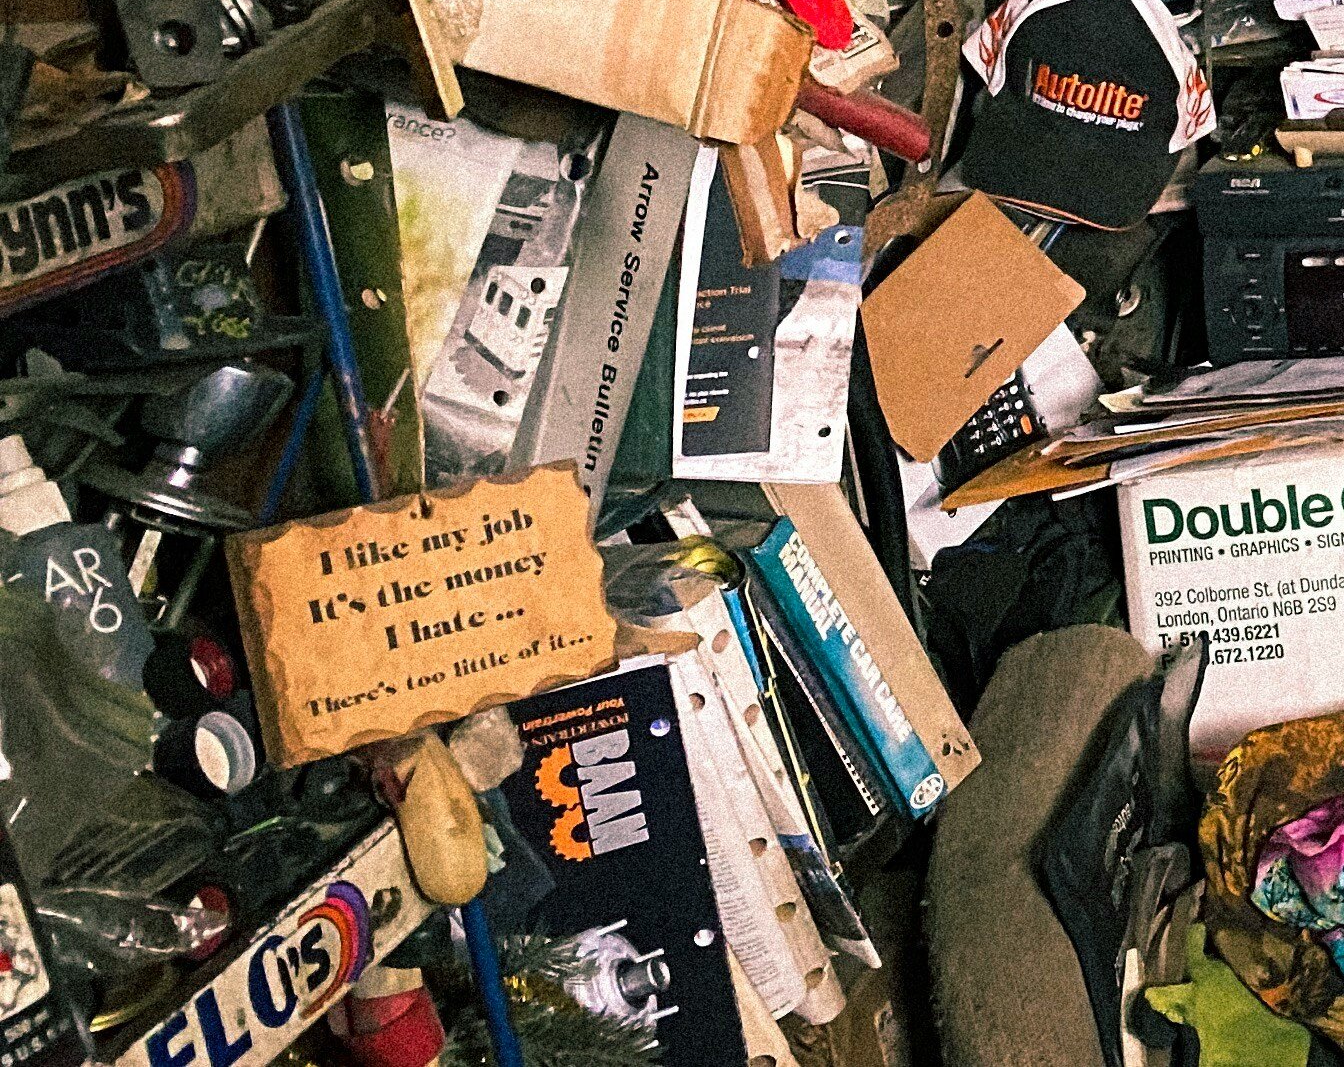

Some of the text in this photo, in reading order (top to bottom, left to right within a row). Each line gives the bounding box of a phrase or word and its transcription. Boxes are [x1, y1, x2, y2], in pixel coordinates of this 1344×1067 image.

[1035, 64, 1144, 120] Autolite
[1066, 107, 1096, 123] change
[631, 162, 660, 244] Arrow
[603, 251, 643, 355] Service
[584, 364, 620, 473] Bulletin
[319, 508, 535, 576] I like my job
[1142, 483, 1335, 545] Double
[1148, 543, 1214, 566] PRINTING
[1229, 536, 1300, 559] GRAPHICS
[88, 586, 123, 634] 6
[307, 551, 549, 626] It's the money
[779, 545, 837, 642] MANUAL
[1154, 590, 1183, 608] 392
[1186, 582, 1251, 606] Colborne
[1253, 581, 1274, 598] St.
[1276, 578, 1297, 599] (at
[1156, 596, 1337, 630] London, Ontario N6B 2S9
[384, 624, 401, 652] I
[410, 605, 487, 644] hate
[789, 531, 913, 744] COMPLETE CAR CARE
[1179, 624, 1281, 648] 51.439.6221
[305, 678, 398, 719] There's
[406, 669, 447, 691] too
[454, 647, 511, 680] little
[517, 640, 546, 663] of
[521, 697, 626, 732] Your Powertrain
[531, 713, 630, 746] POWERTRAIN
